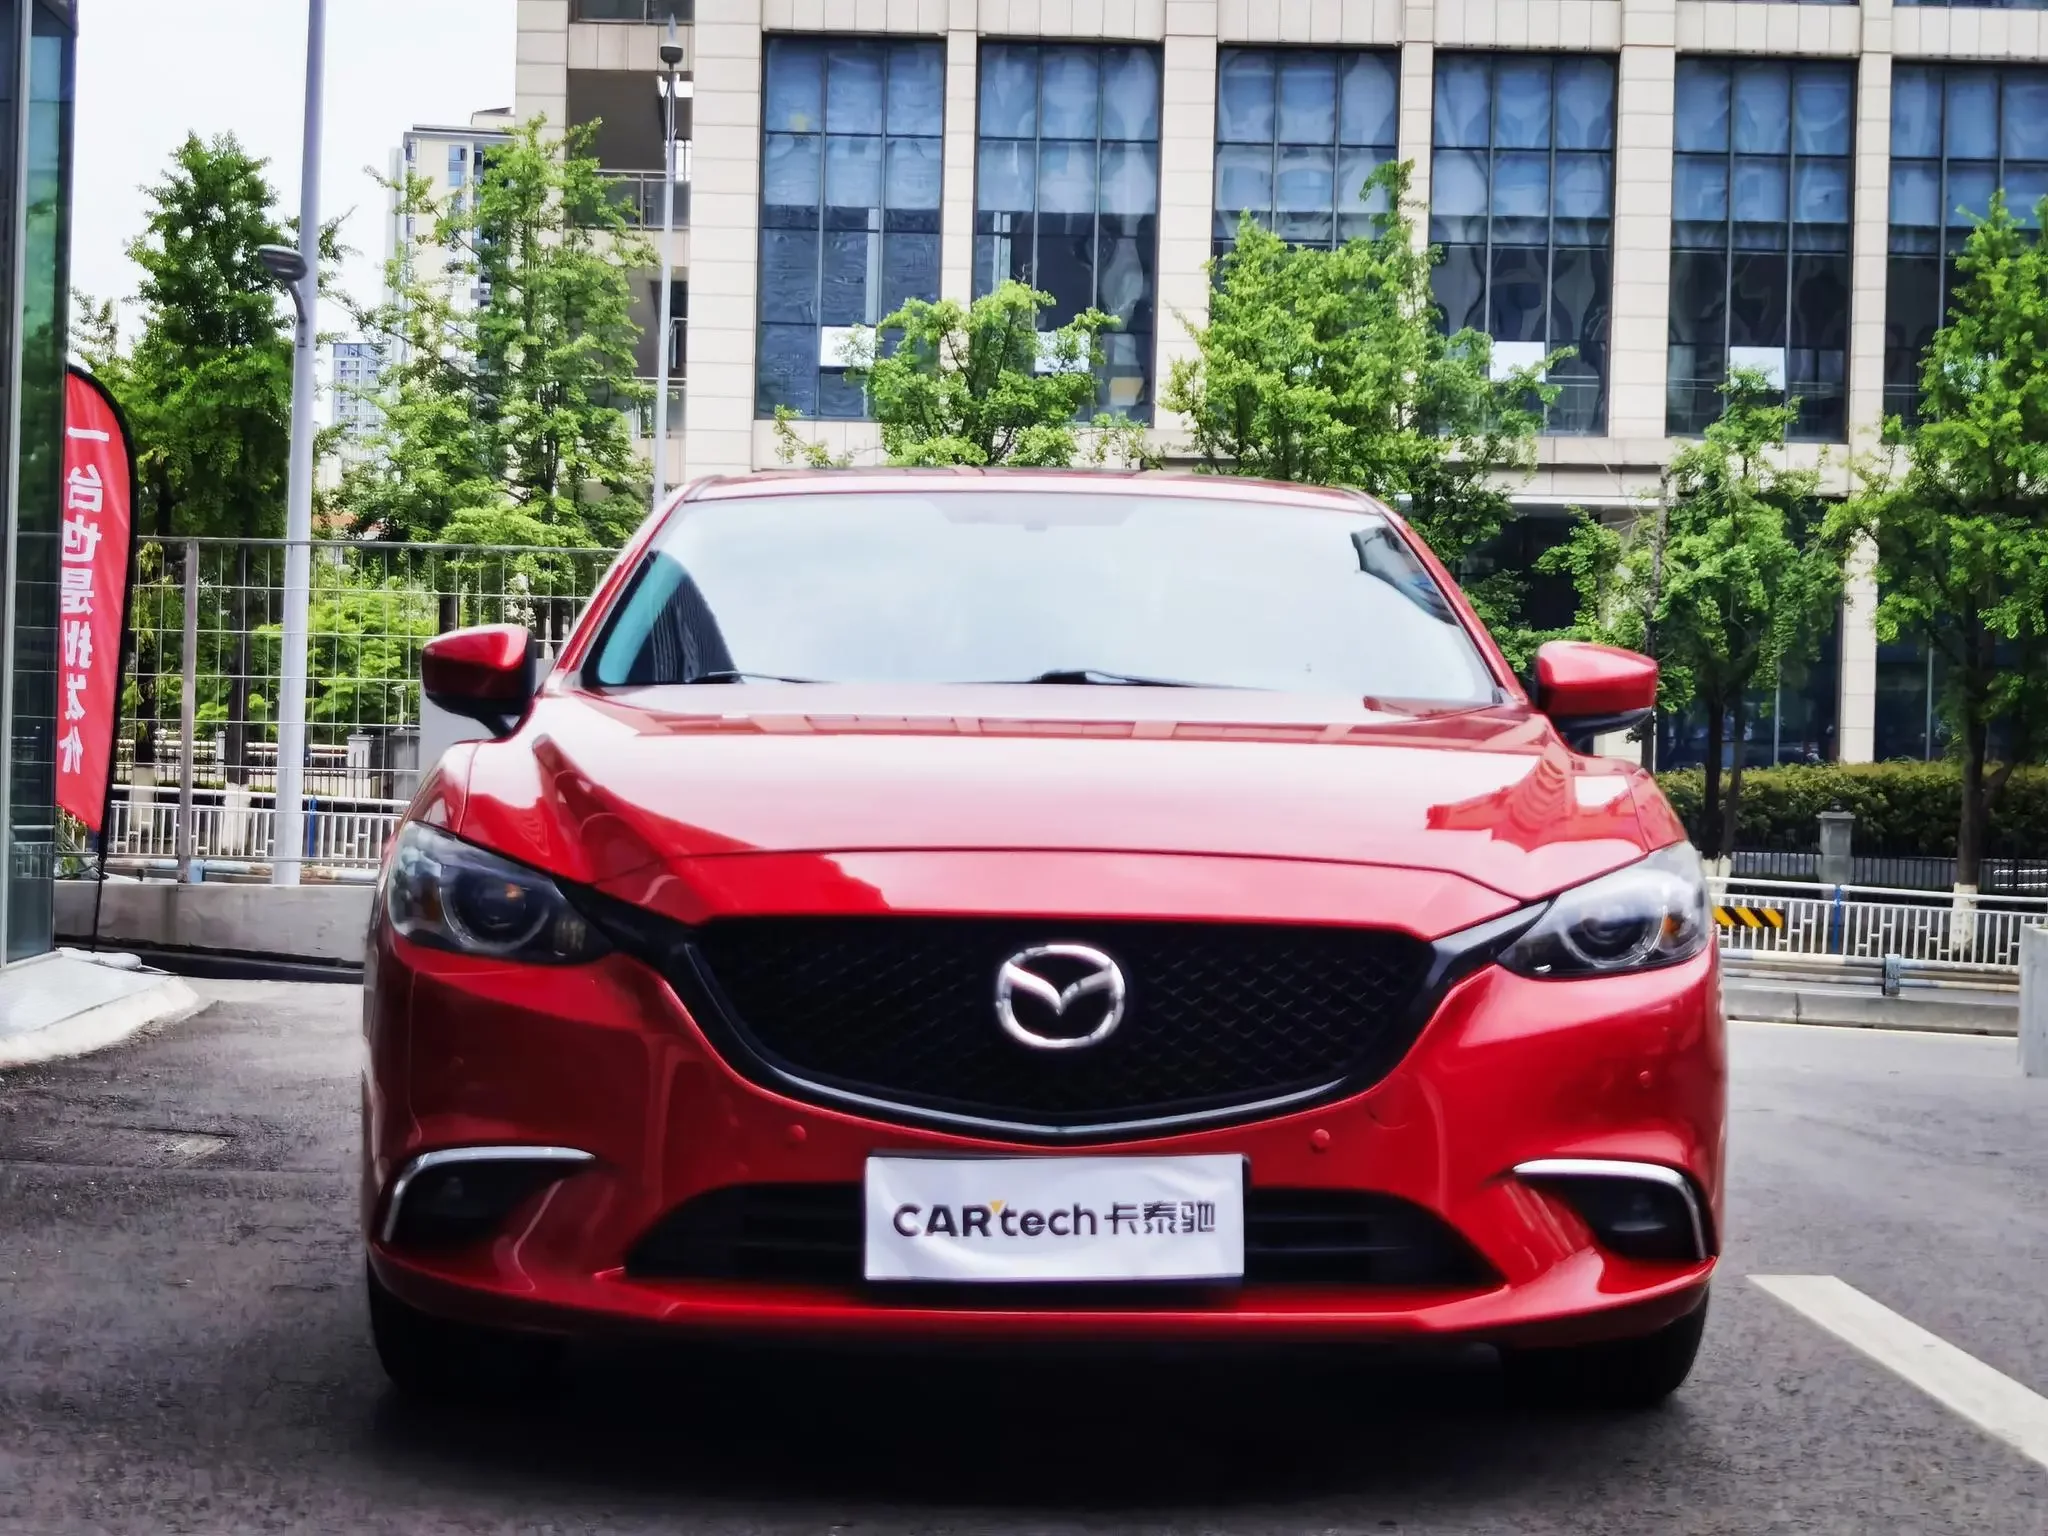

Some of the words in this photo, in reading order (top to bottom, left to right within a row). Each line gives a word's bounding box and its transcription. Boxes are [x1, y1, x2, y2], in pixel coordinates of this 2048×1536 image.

[893, 1201, 1098, 1238] CARtech
[1104, 1200, 1216, 1236] 卡泰驰
